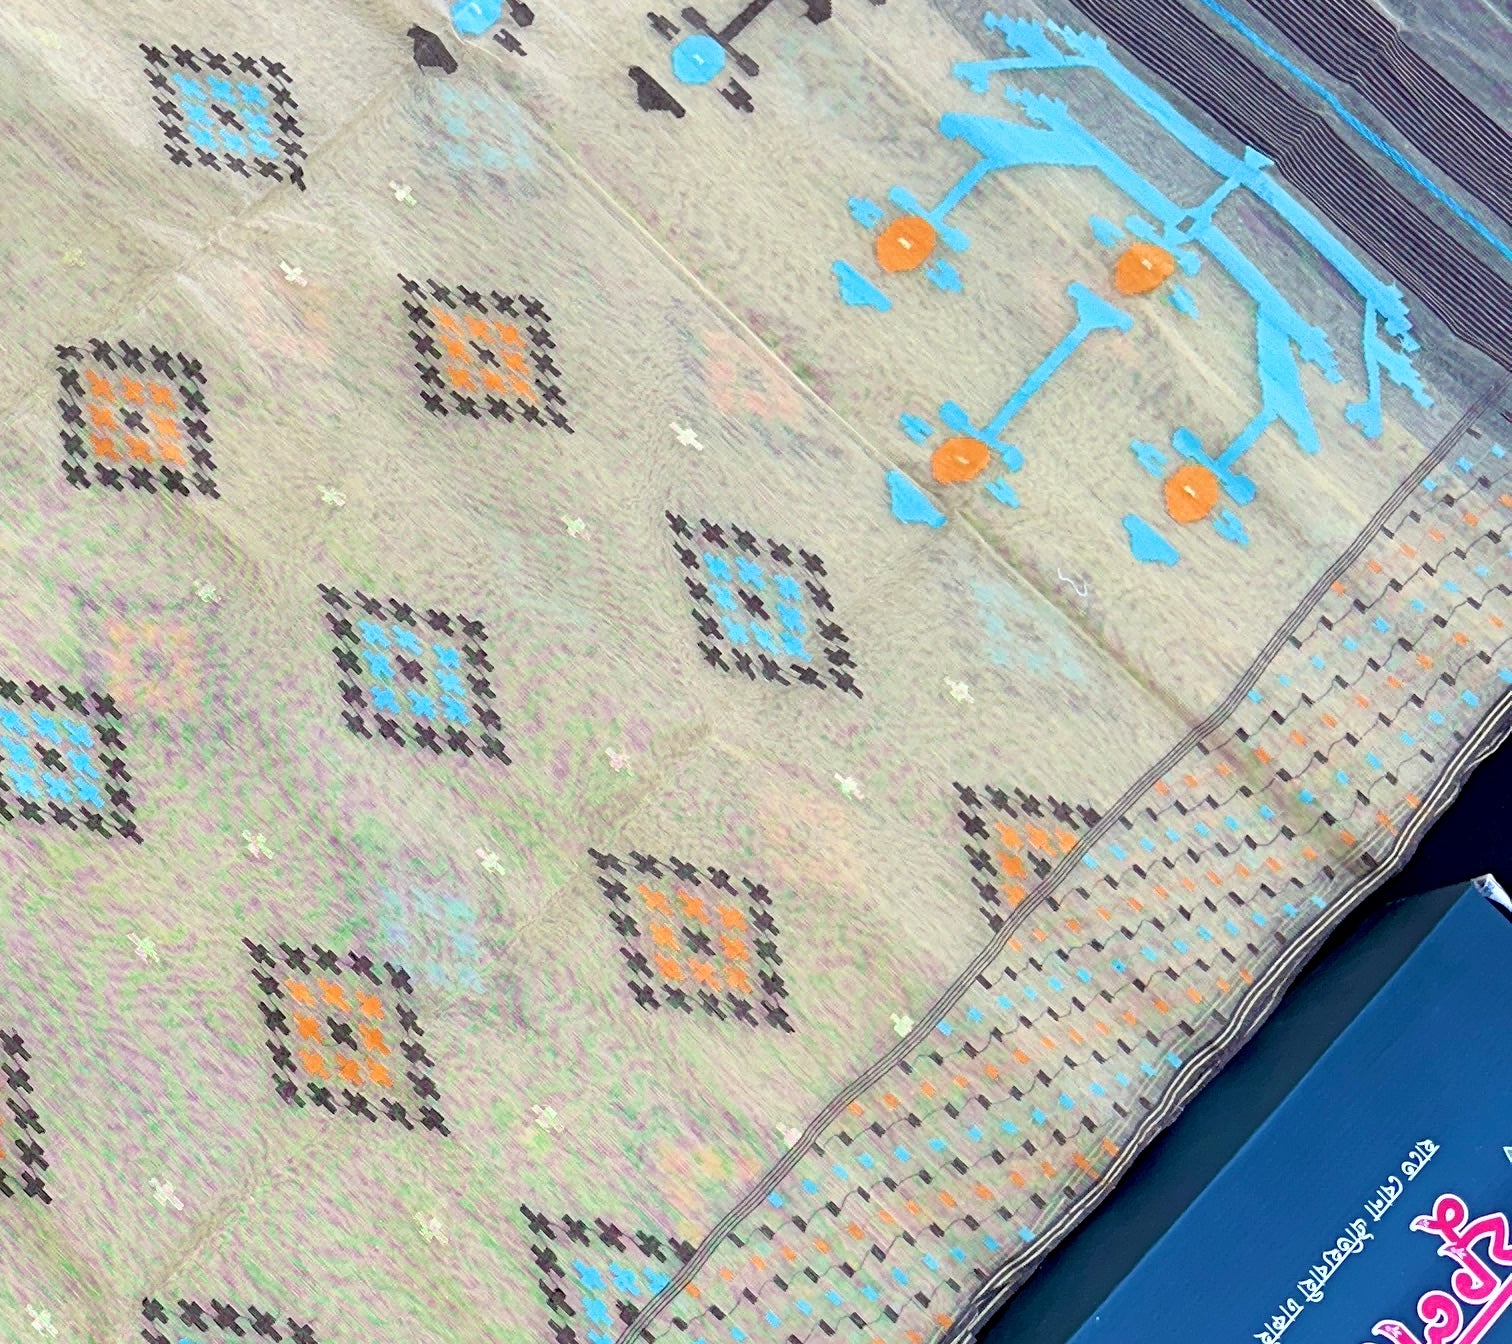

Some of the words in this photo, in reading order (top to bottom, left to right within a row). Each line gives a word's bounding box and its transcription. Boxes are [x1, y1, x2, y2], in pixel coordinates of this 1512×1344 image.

[1401, 1139, 1440, 1182] হাতে
[1363, 1175, 1404, 1222] বোনা
[1296, 1218, 1375, 1303] ঐতিহ্যবাহী
